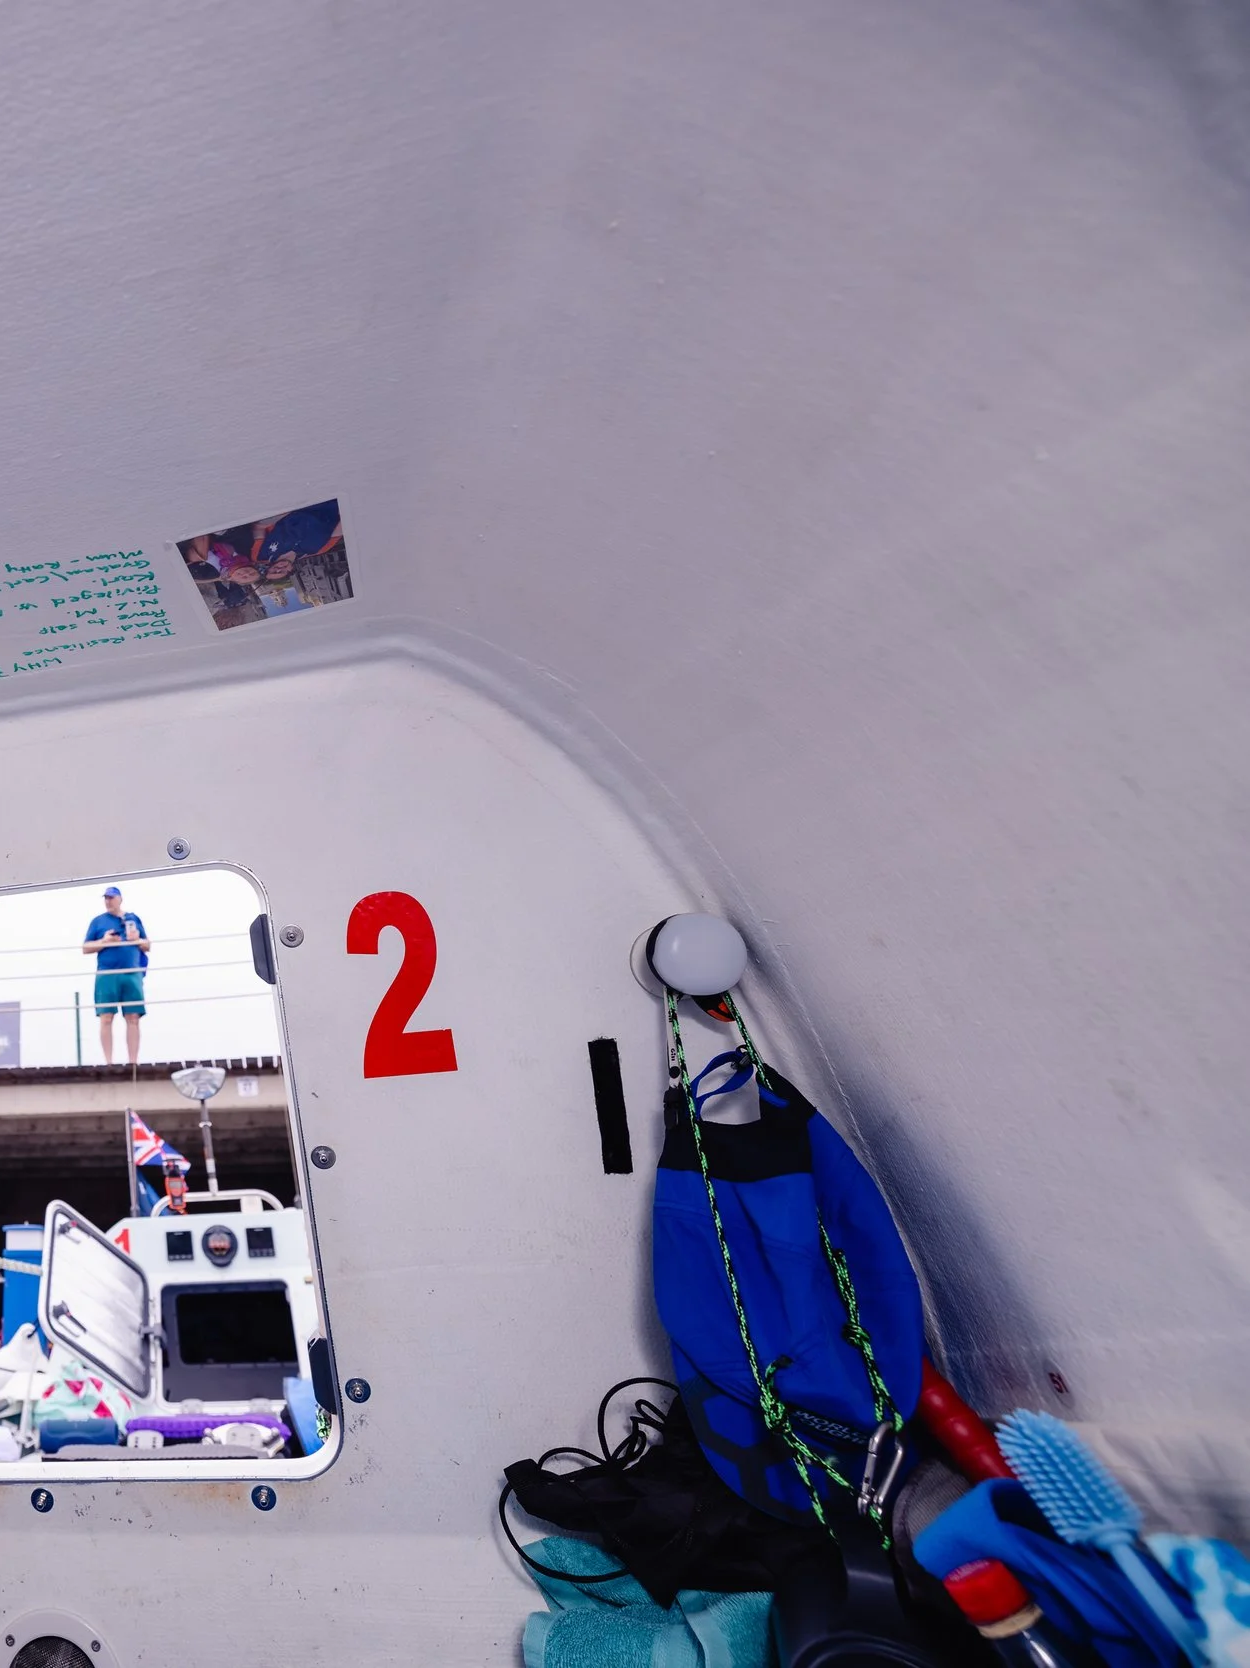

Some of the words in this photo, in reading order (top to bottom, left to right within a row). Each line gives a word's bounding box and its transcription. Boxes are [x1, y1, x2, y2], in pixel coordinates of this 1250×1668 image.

[134, 628, 176, 639] Test
[22, 636, 125, 656] Resilience
[347, 891, 458, 1079] 2
[114, 1228, 131, 1256] 1
